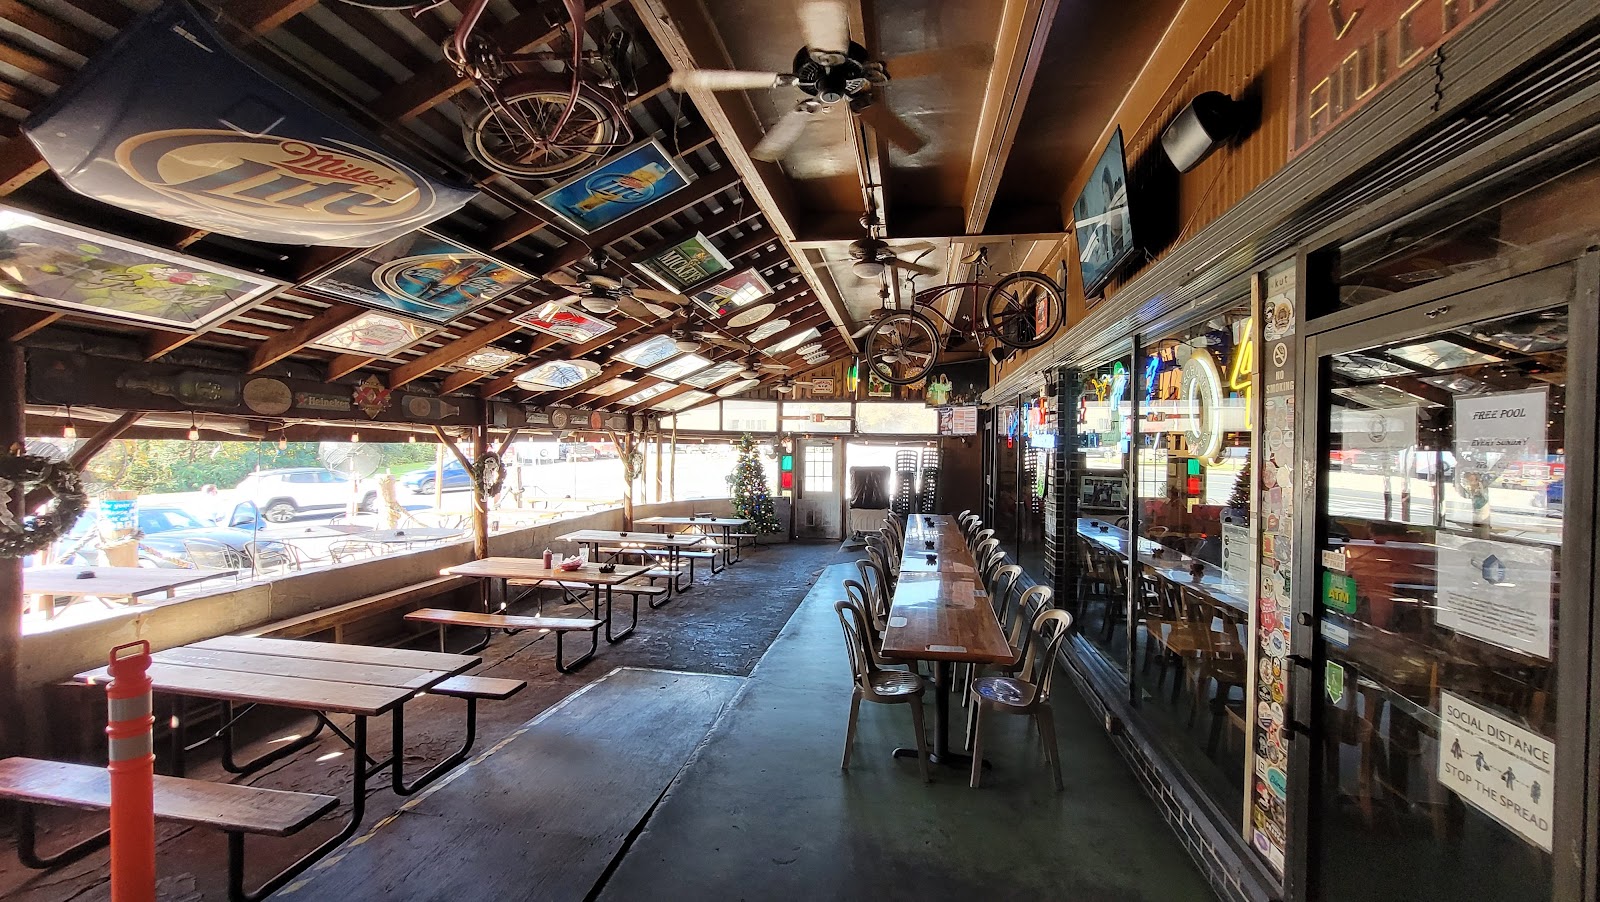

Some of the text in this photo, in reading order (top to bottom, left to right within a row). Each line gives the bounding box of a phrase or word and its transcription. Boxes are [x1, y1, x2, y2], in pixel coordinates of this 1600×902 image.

[269, 141, 397, 189] Miller
[163, 157, 388, 214] Lite
[591, 179, 644, 200] Lite
[1275, 370, 1285, 381] NO
[1266, 380, 1295, 394] SMOKING
[308, 396, 350, 408] Heineken
[1472, 408, 1526, 420] FREE POOL
[1328, 588, 1350, 604] ATM
[1446, 704, 1484, 733] SOCIAL
[1487, 724, 1550, 765] DISTANCE
[1445, 762, 1549, 832] STOP THE SPREAD
